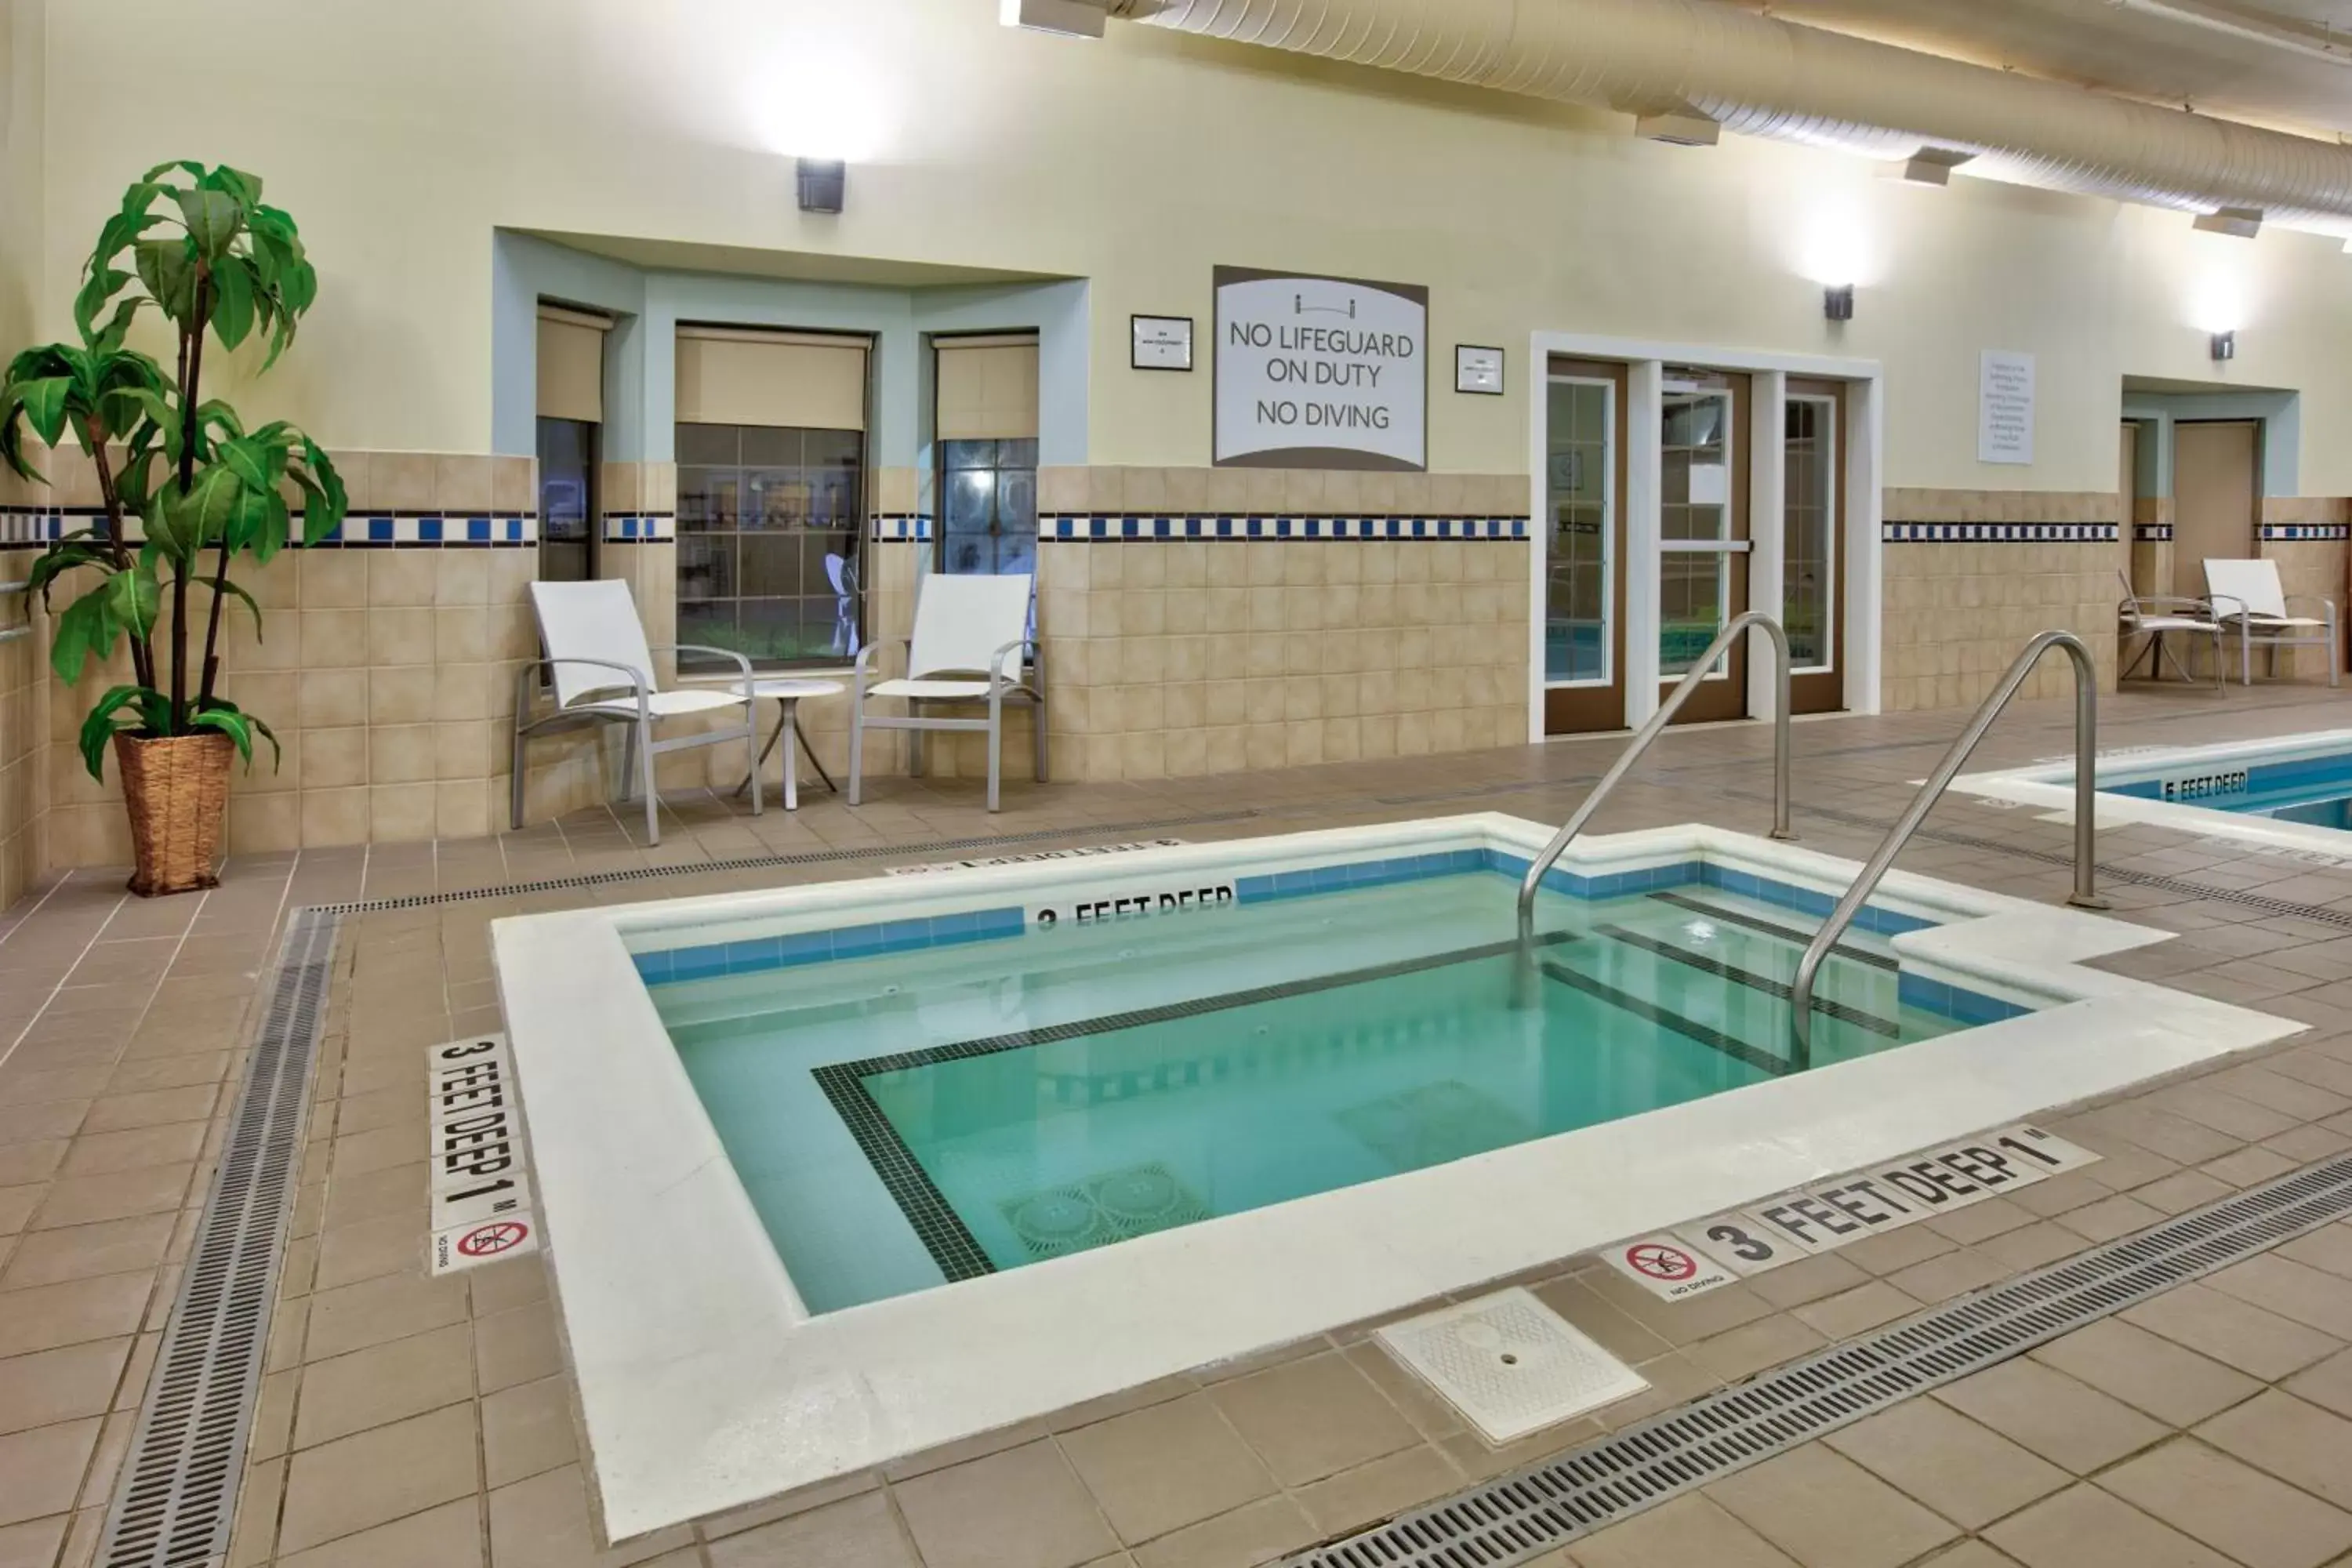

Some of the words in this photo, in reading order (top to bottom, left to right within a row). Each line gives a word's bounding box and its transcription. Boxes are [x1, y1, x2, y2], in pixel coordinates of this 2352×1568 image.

[1231, 321, 1272, 347] NO
[1279, 325, 1414, 358] LIFEGUARD
[1267, 358, 1307, 383] ON
[1316, 361, 1382, 388] DUTY
[1258, 400, 1298, 425] NO
[1305, 402, 1389, 429] DIVING
[441, 1041, 495, 1059] 3
[441, 1061, 503, 1116] FEET
[445, 1112, 511, 1174] DEEP
[445, 1179, 515, 1203] 1
[1707, 1225, 1773, 1261] 3
[1760, 1181, 1911, 1244] FEET
[1882, 1147, 2018, 1205] DEEP
[1998, 1136, 2061, 1166] 1
[1670, 1286, 1688, 1295] NO
[1689, 1275, 1726, 1291] DIVING
